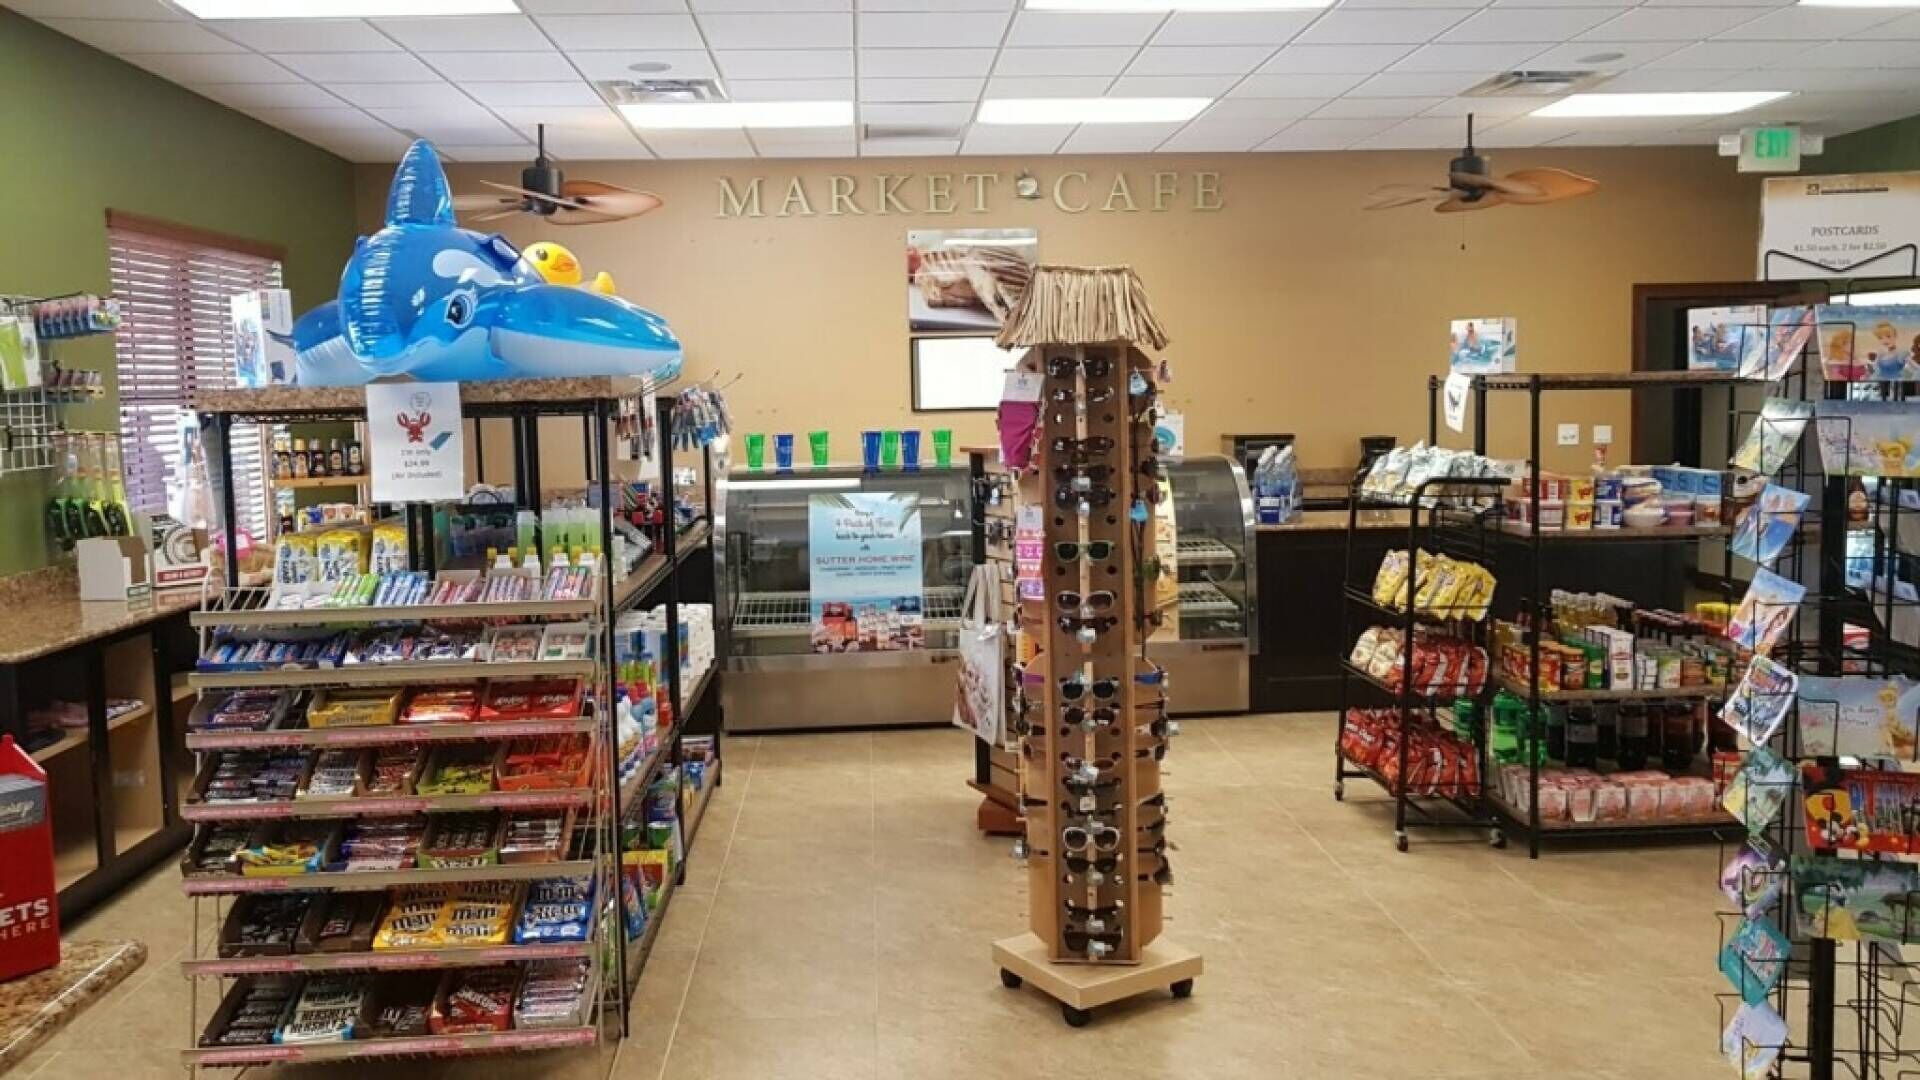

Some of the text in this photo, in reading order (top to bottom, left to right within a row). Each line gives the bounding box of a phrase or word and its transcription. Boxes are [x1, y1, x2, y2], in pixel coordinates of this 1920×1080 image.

[1754, 128, 1791, 159] EXIT
[717, 171, 1225, 218] MARKET CAFE
[1810, 224, 1880, 238] POSTCARDS
[815, 556, 856, 564] SUTTER
[858, 554, 887, 563] HOME
